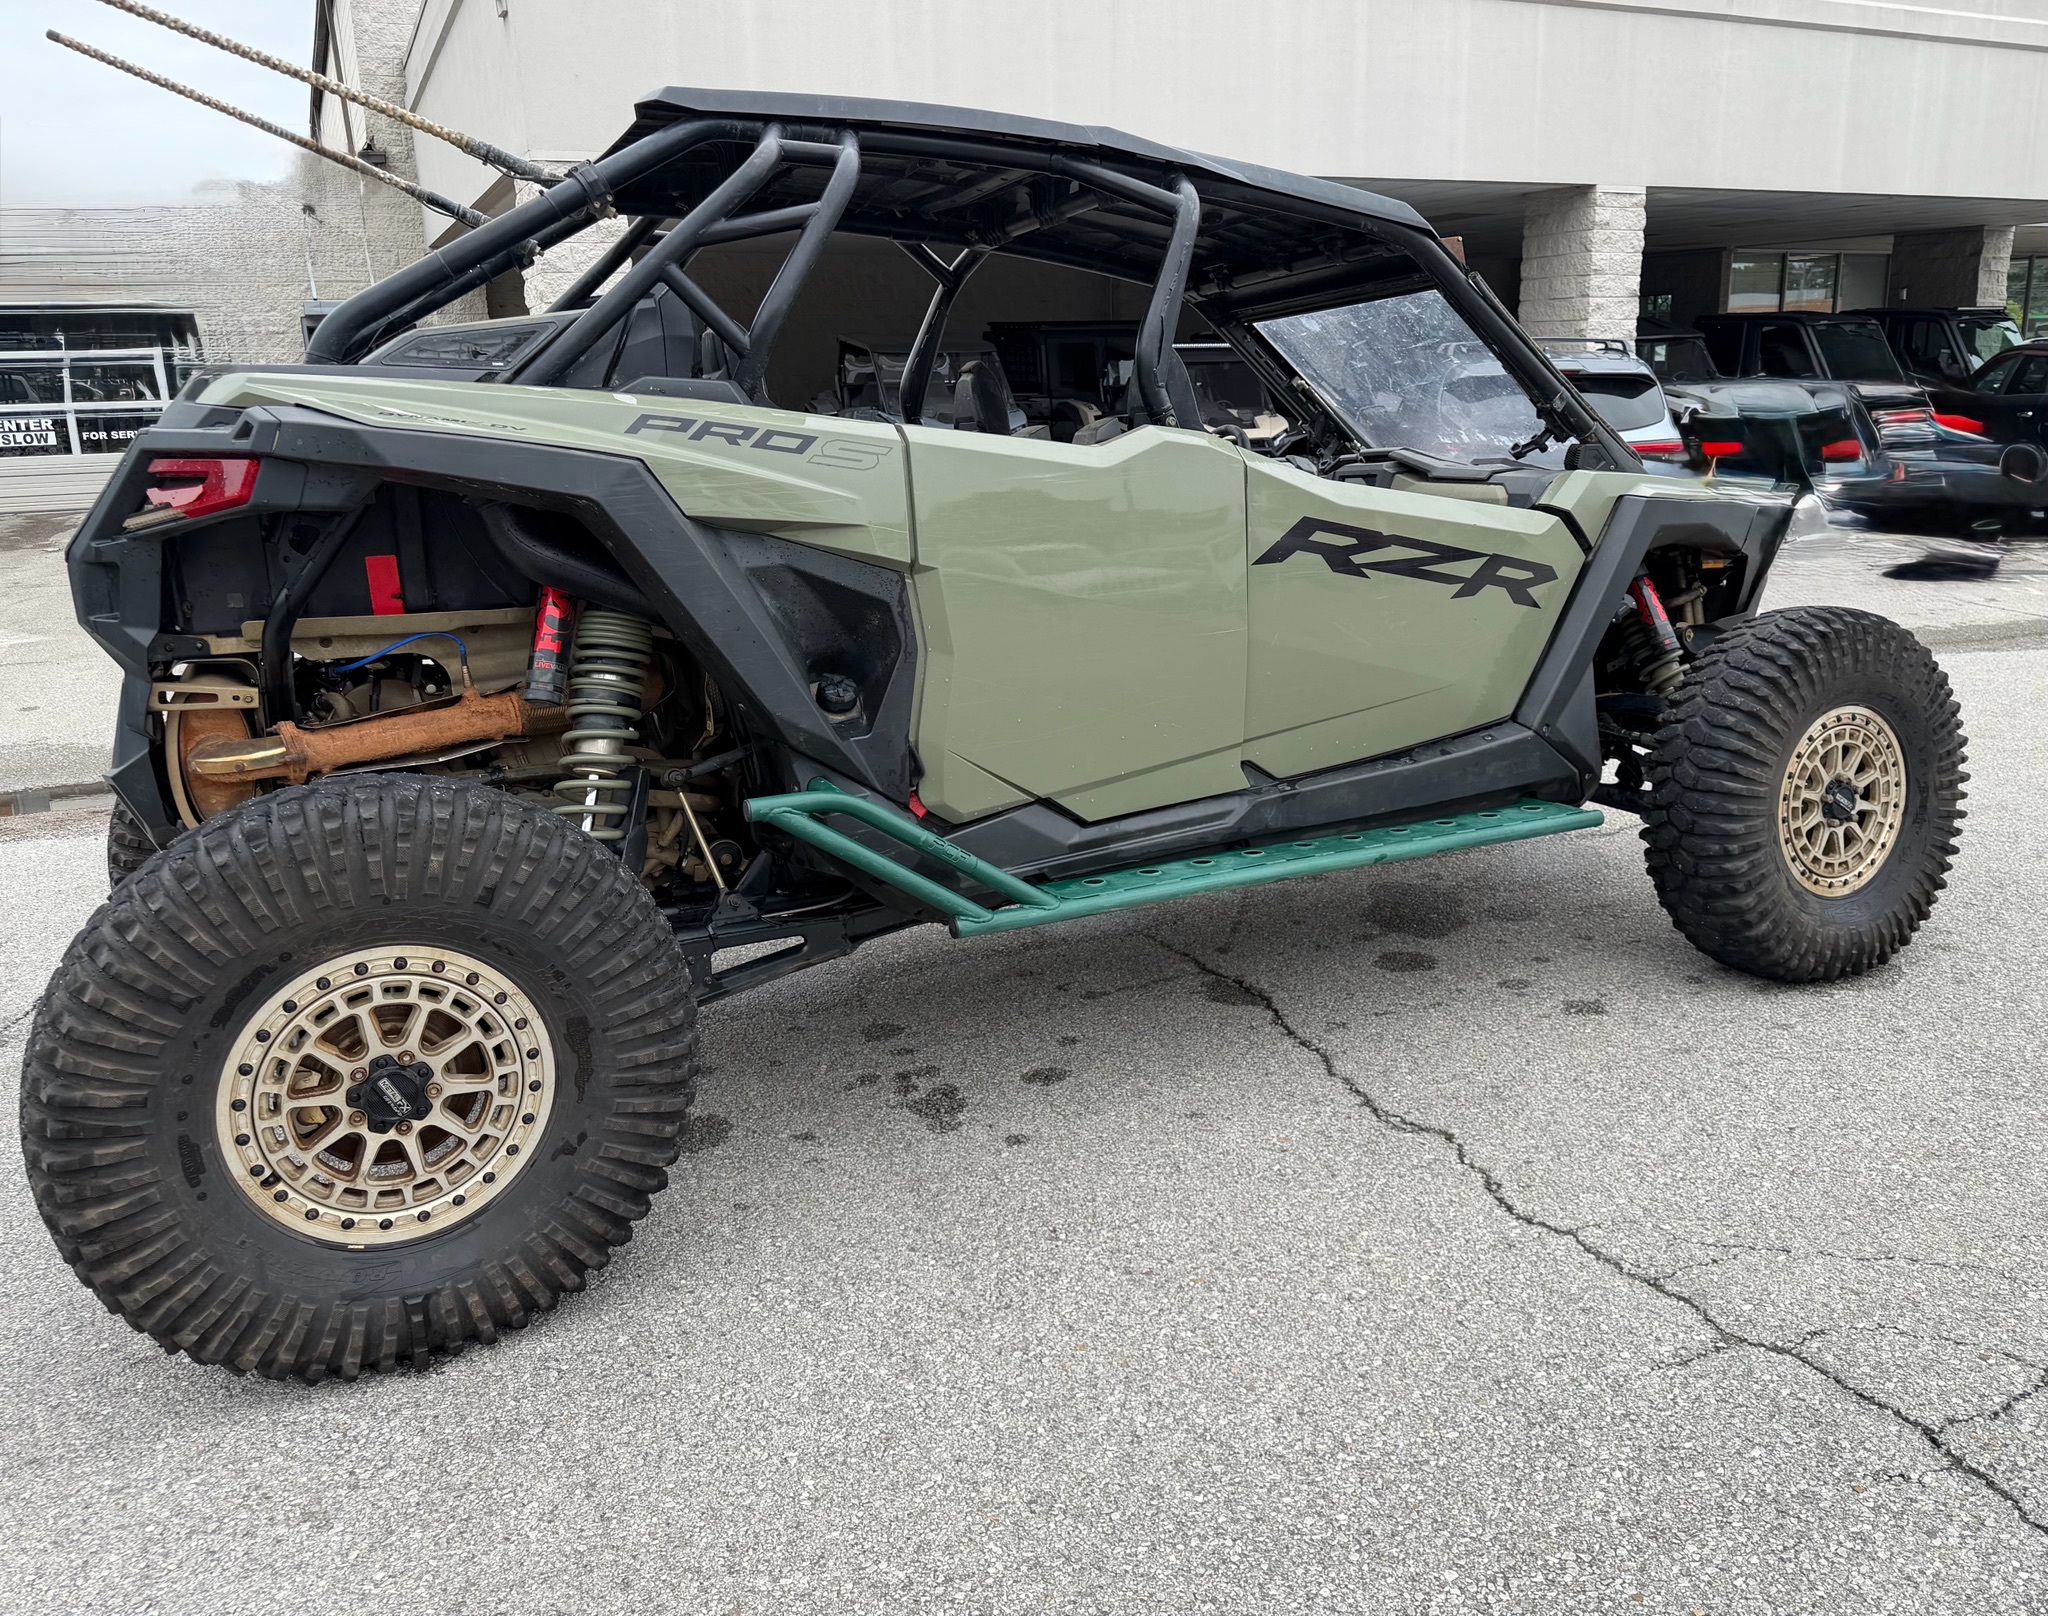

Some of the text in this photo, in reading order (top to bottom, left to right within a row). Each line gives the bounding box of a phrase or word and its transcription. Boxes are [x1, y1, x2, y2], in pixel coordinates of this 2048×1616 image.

[0, 419, 55, 432] NTER
[1, 432, 49, 446] SLOW
[82, 431, 108, 440] FOR
[1250, 515, 1559, 610] RZR
[533, 585, 574, 655] FOX
